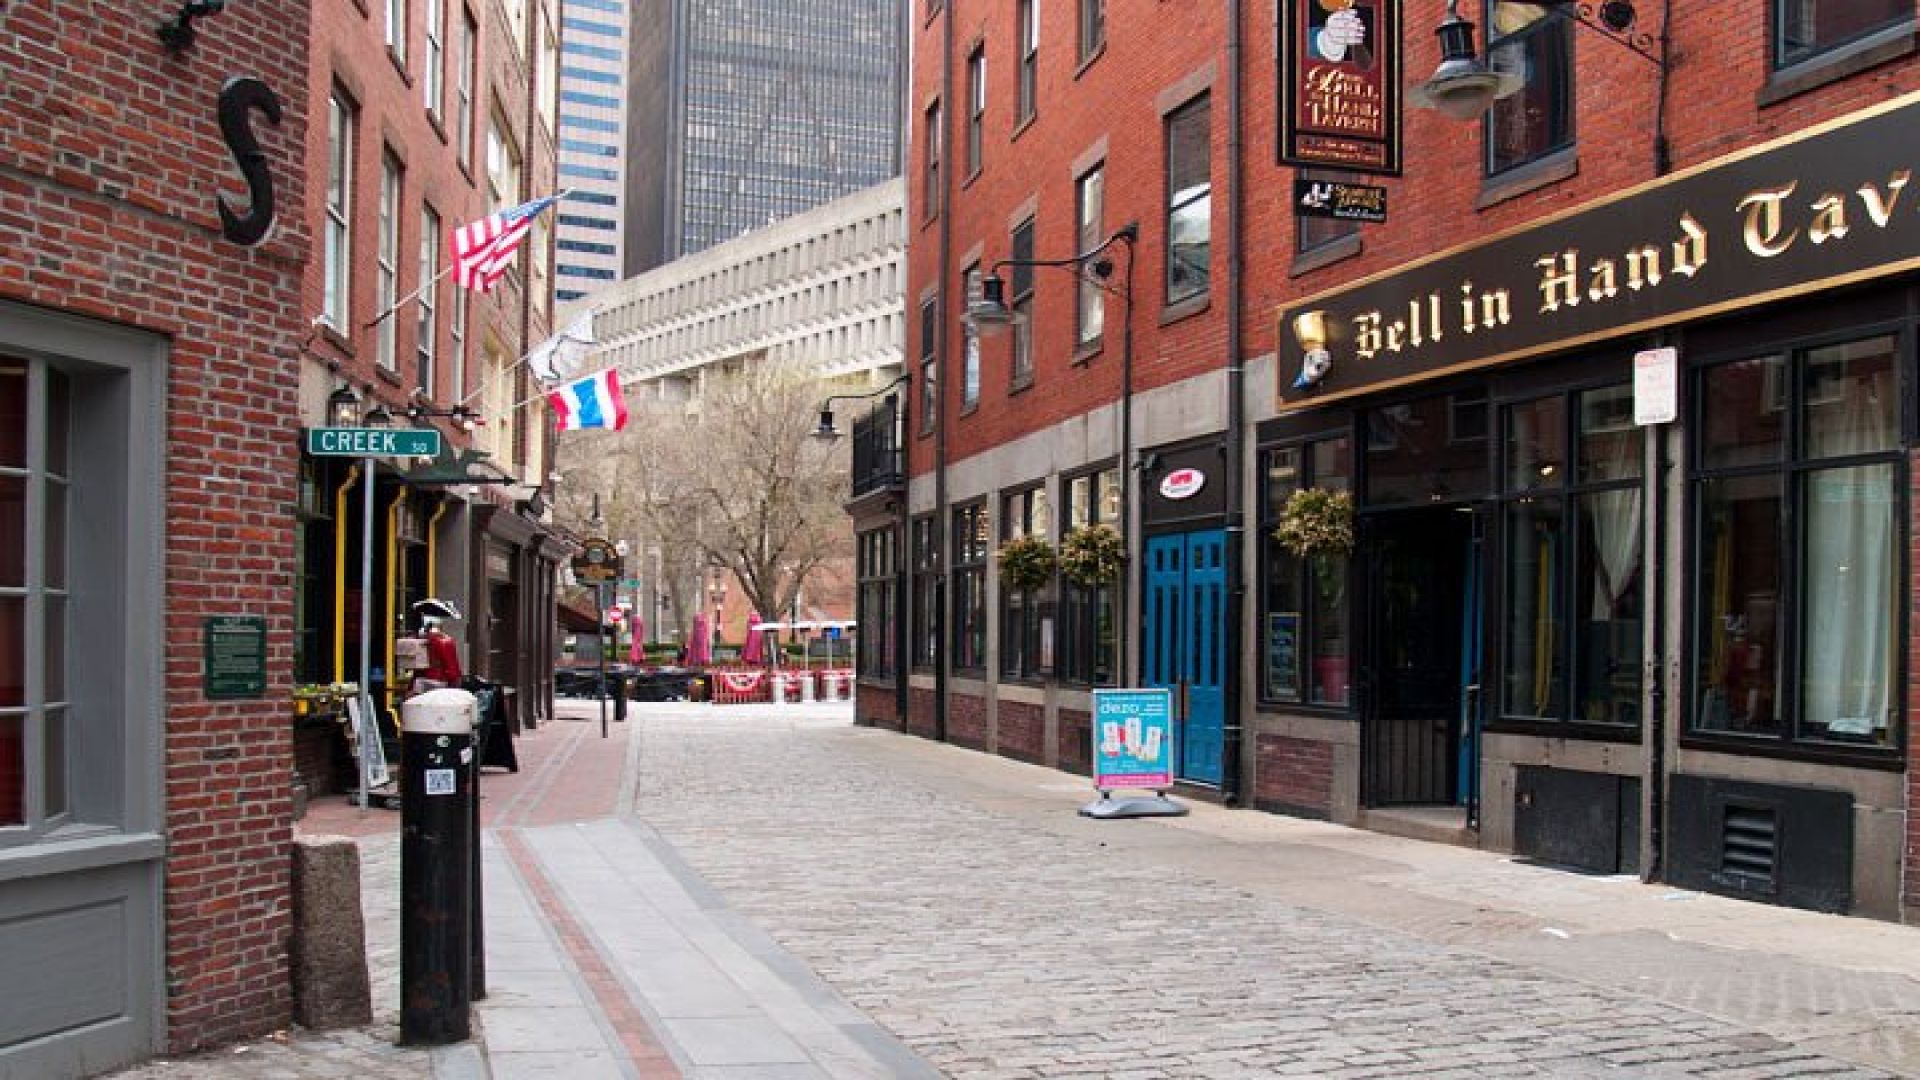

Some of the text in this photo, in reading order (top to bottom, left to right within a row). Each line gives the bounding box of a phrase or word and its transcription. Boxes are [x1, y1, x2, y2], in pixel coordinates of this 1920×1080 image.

[1353, 293, 1443, 359] Bell
[1461, 280, 1512, 334] in
[1534, 212, 1707, 314] Hand
[322, 431, 396, 451] CREEK
